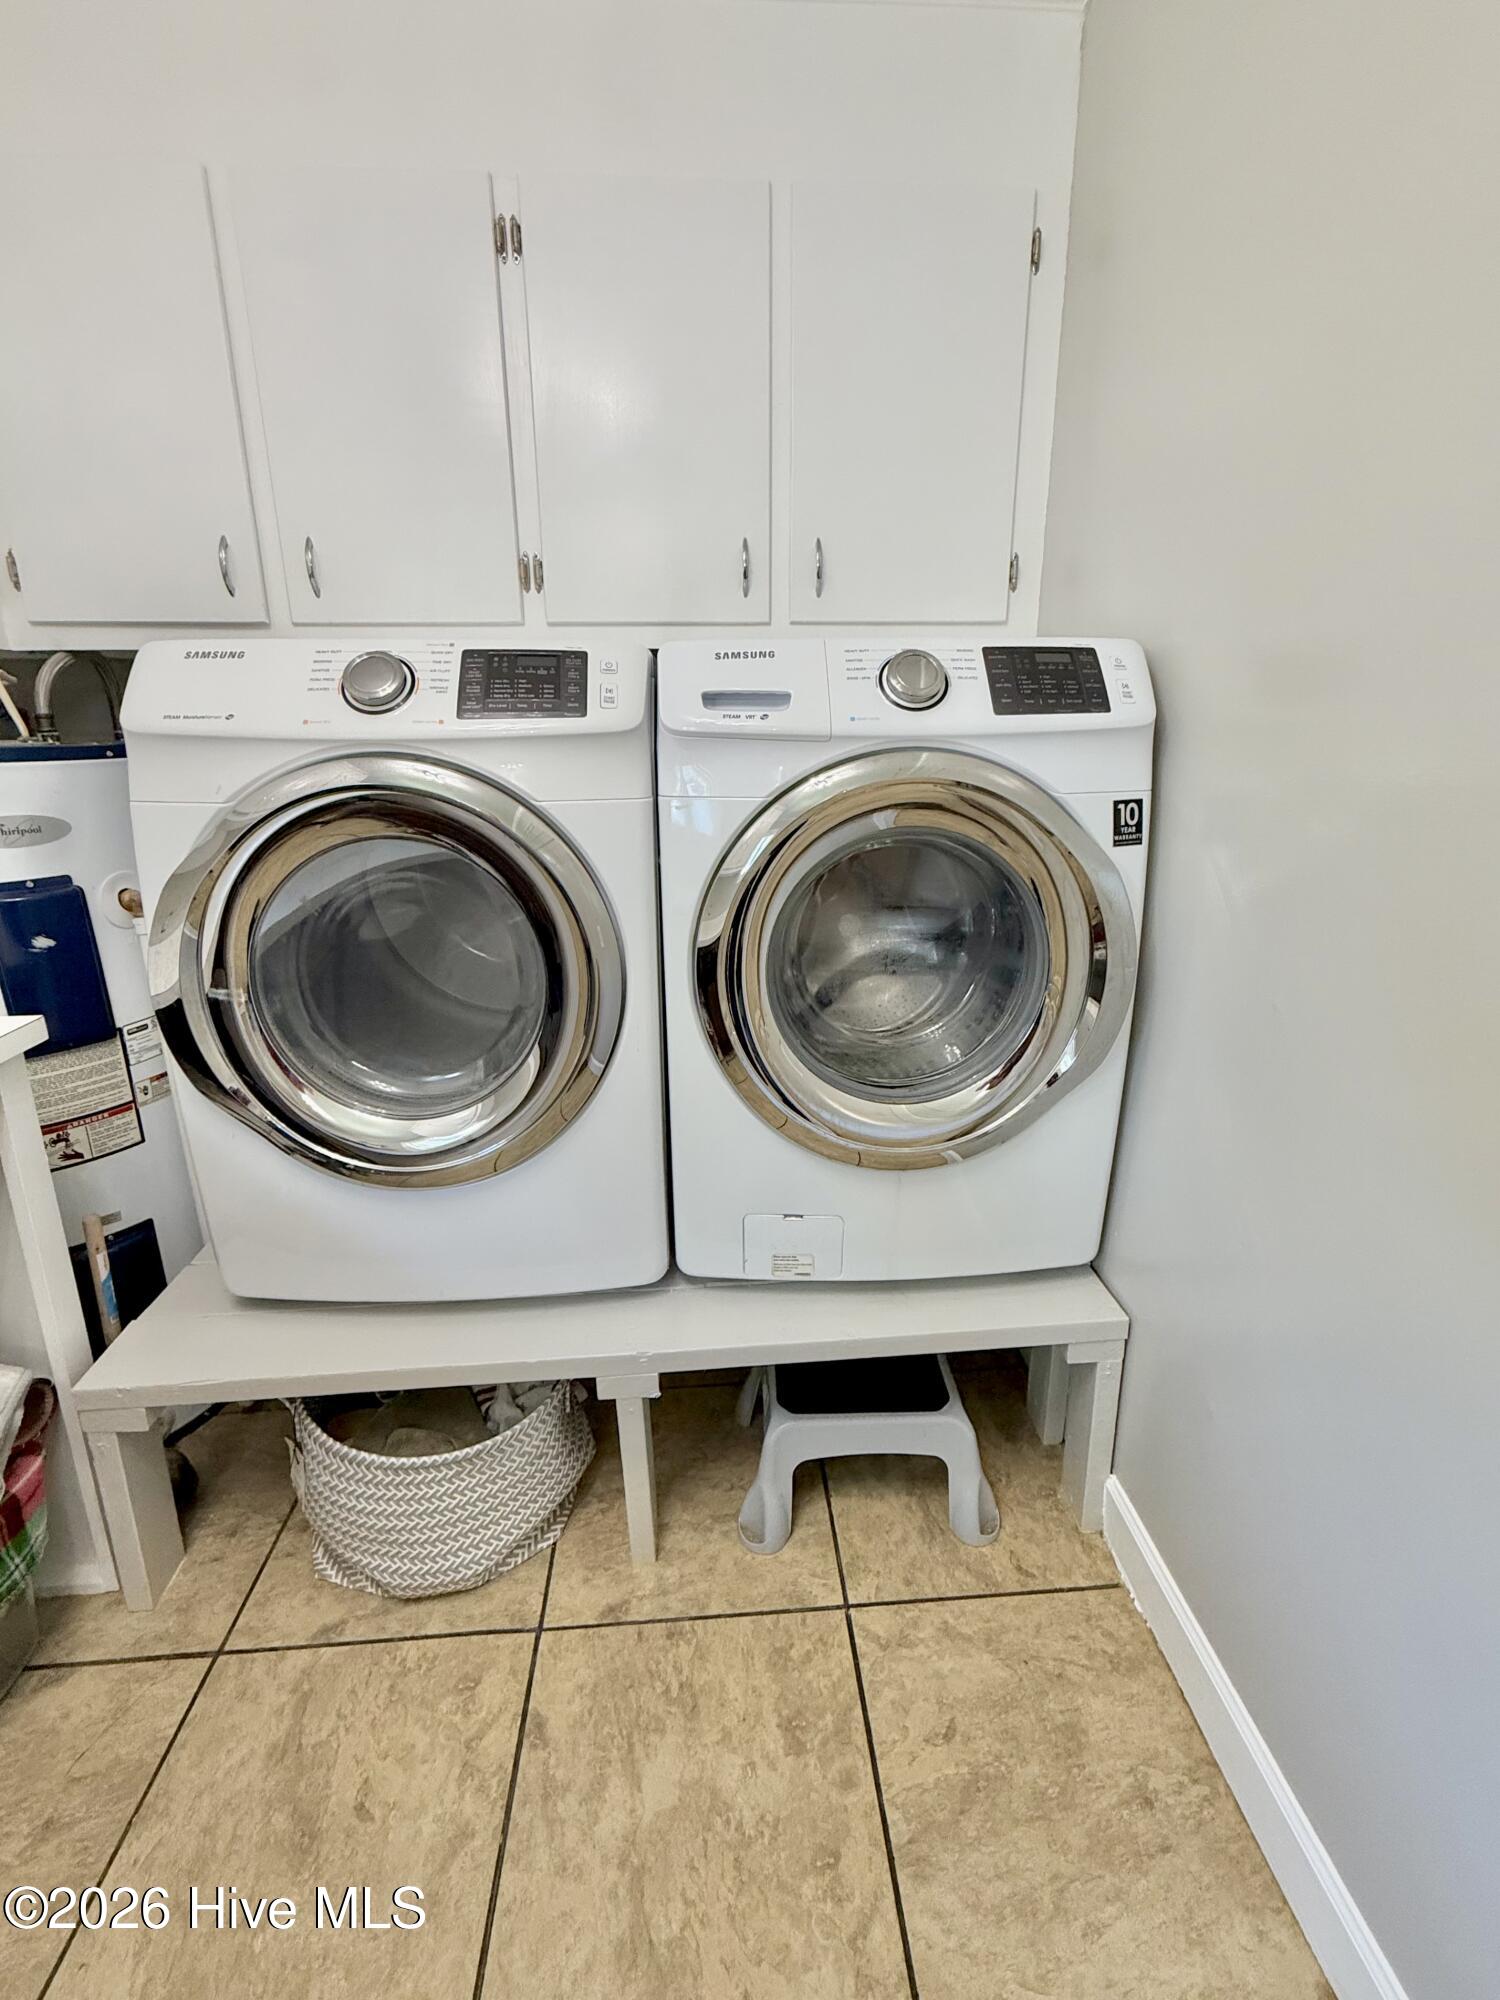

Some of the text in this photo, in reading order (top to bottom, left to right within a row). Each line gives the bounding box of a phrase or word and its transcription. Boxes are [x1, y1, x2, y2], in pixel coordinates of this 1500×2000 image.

[184, 650, 246, 660] SAMSUNG
[714, 650, 776, 660] SAMSUNG
[1117, 802, 1139, 826] 10
[0, 823, 42, 837] hirlpool
[1120, 826, 1136, 834] YEAR
[1113, 833, 1142, 841] WARRANTY
